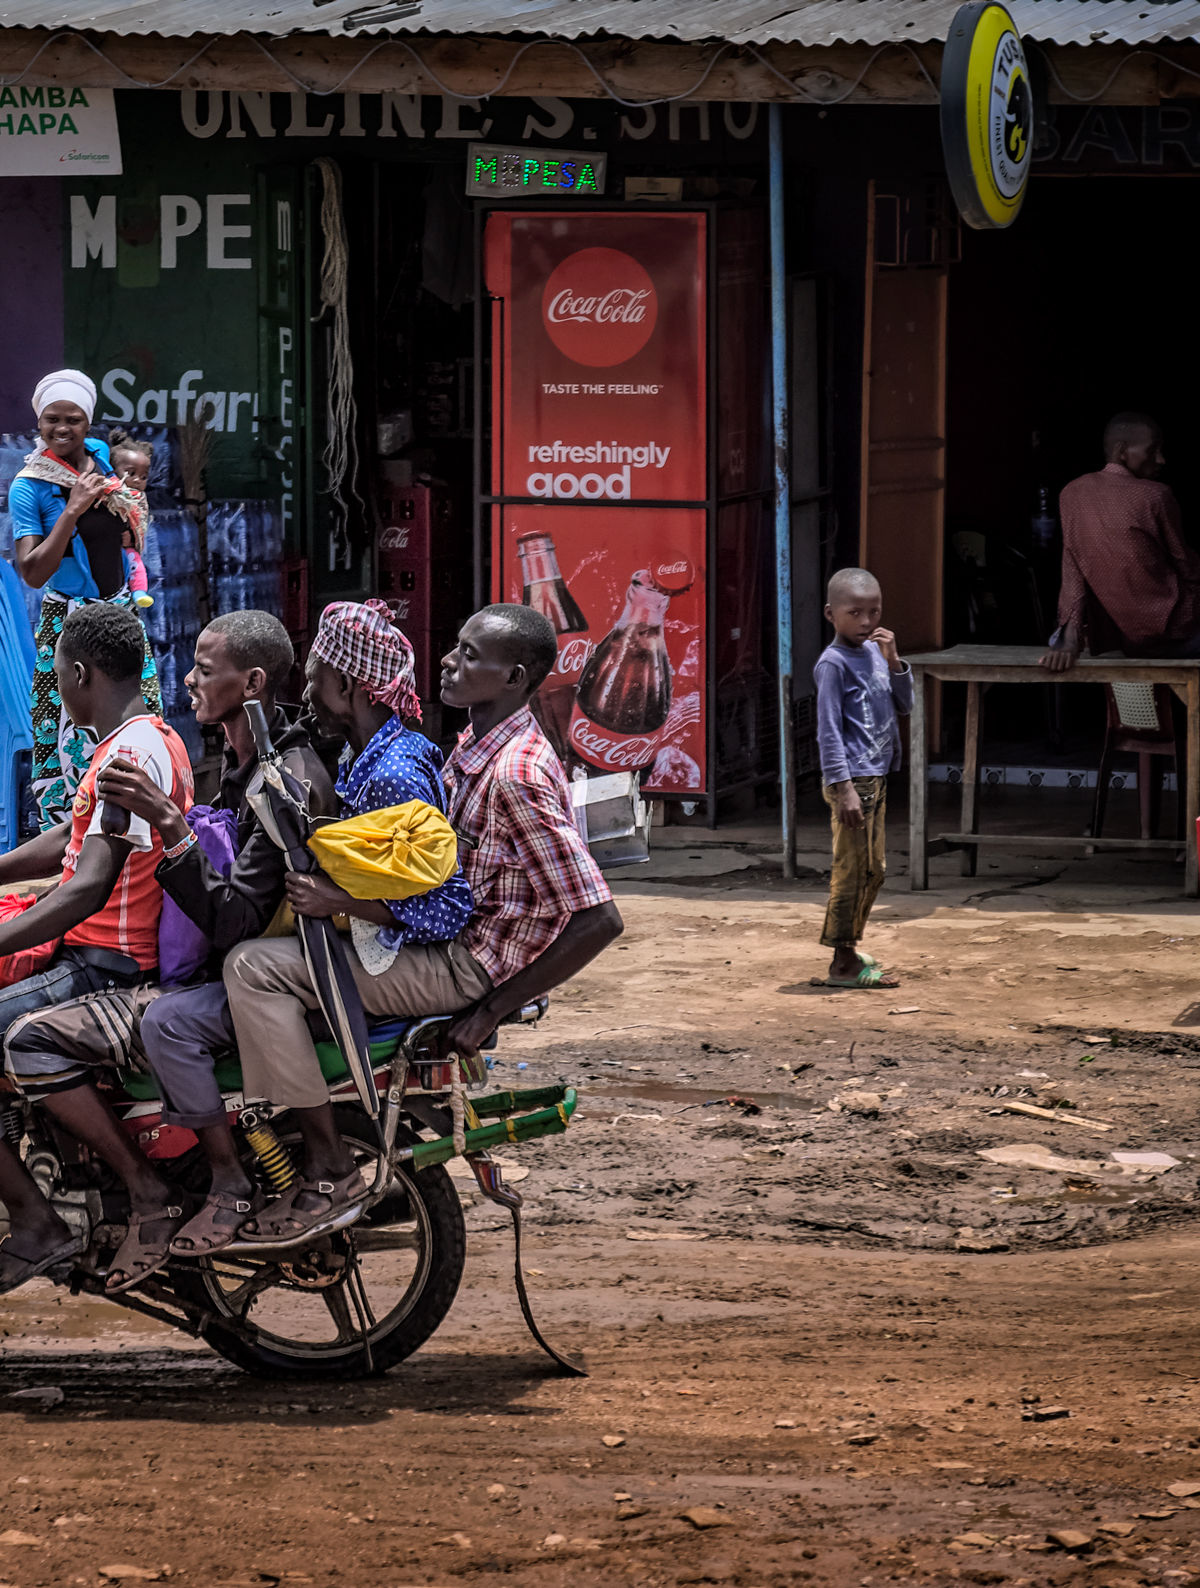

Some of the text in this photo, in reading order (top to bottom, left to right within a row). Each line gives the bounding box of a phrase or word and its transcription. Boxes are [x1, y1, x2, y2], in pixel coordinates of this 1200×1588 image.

[542, 383, 580, 394] TASTE
[582, 384, 605, 394] THE
[528, 440, 671, 468] refreshingly
